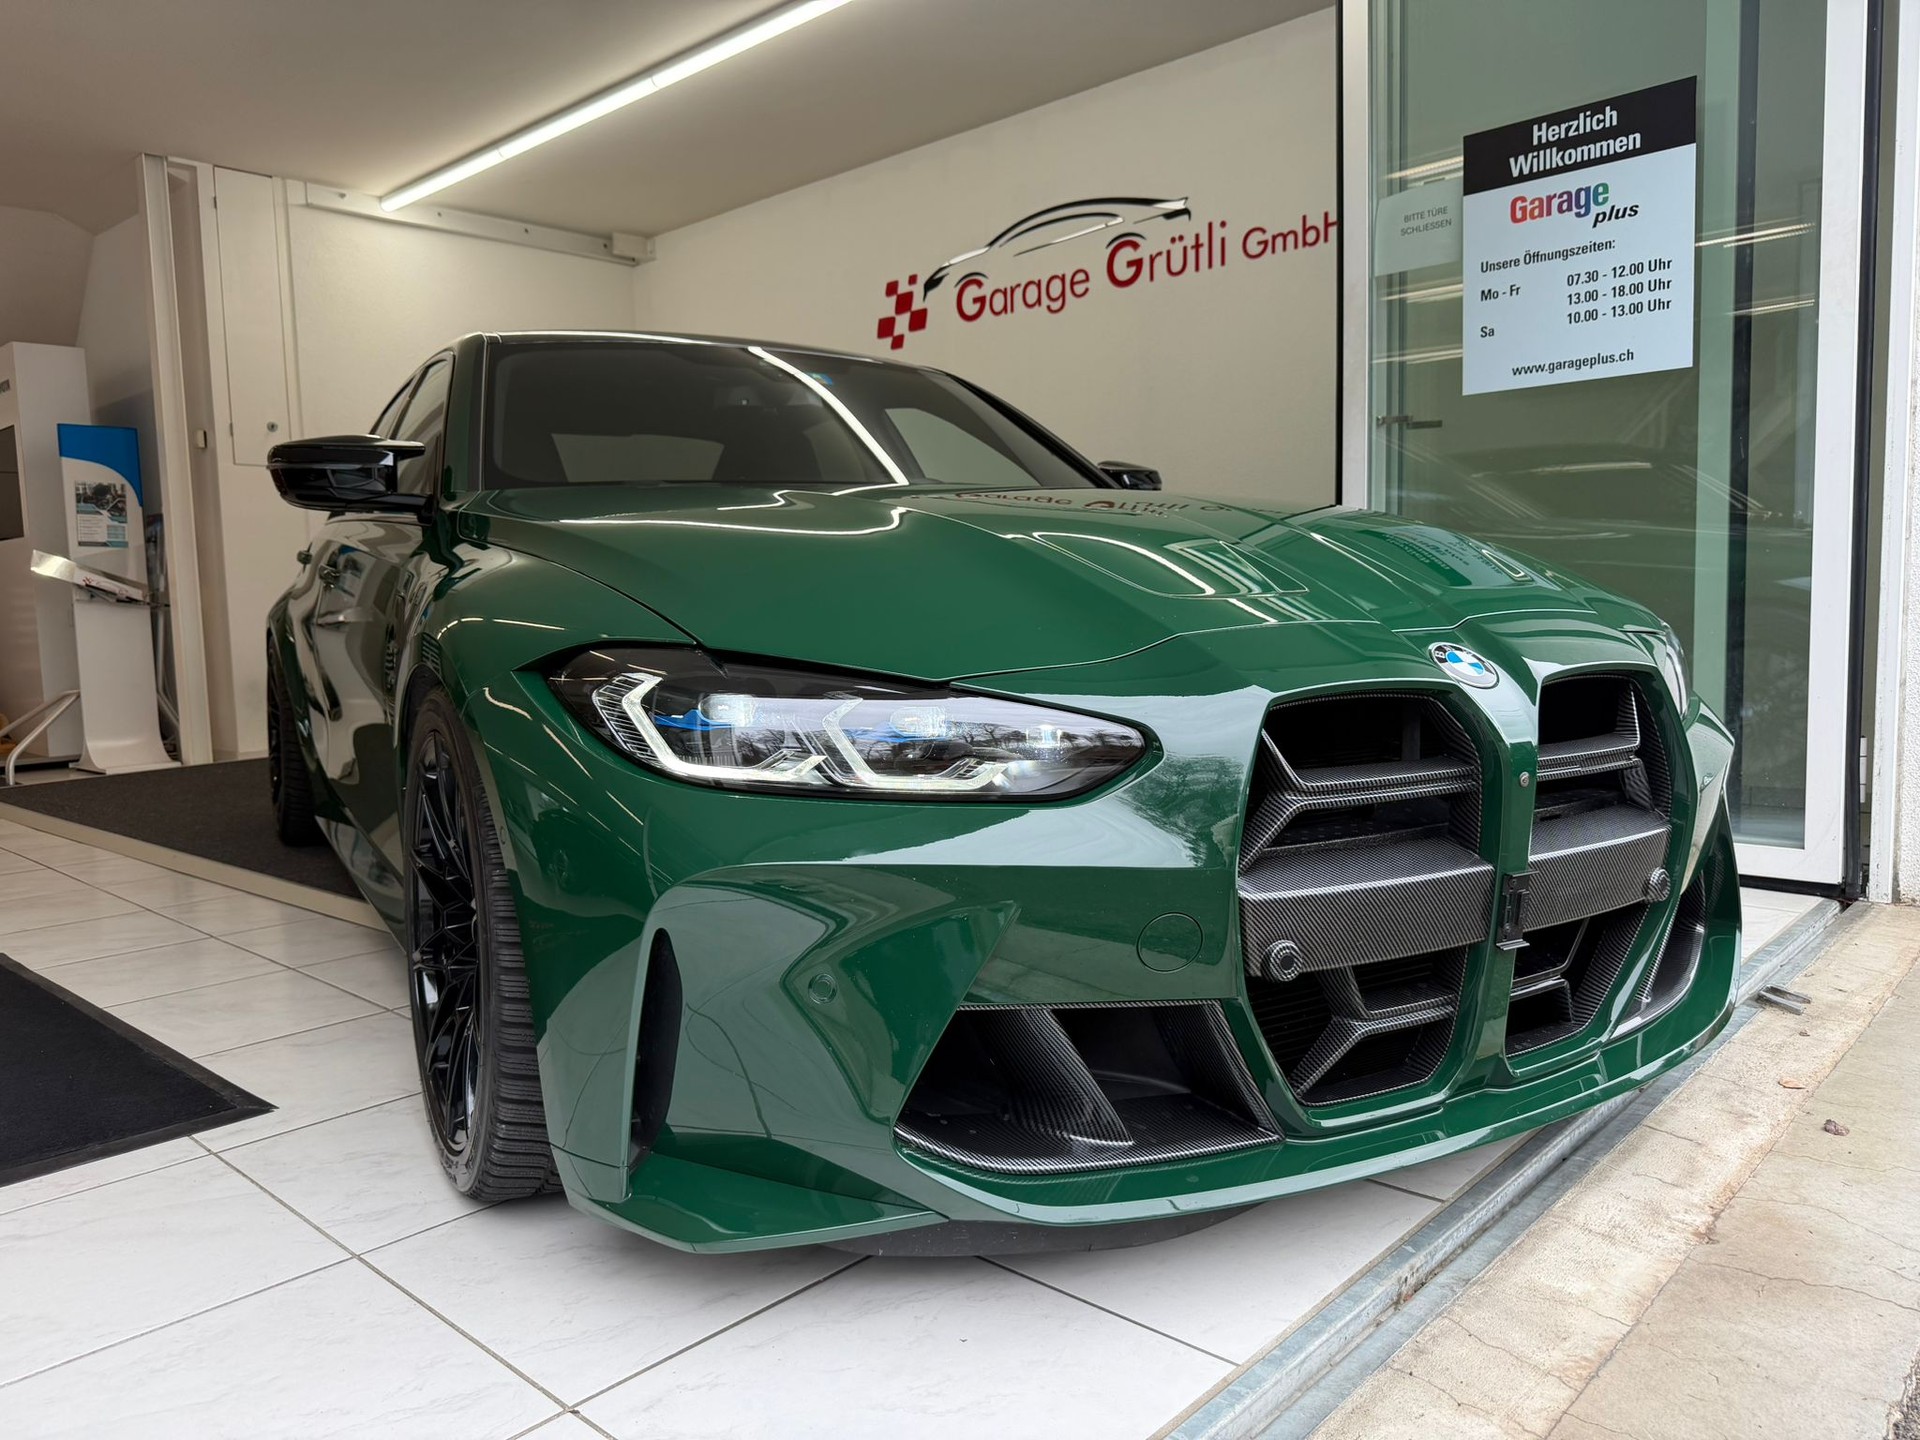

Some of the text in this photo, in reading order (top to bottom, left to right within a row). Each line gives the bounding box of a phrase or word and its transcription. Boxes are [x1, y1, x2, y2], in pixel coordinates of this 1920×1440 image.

[1532, 105, 1618, 146] Herzlich
[1508, 132, 1642, 178] Willkommen
[1403, 205, 1449, 223] BITTE TÜRE
[1509, 182, 1610, 224] Garage
[1592, 204, 1640, 229] plus
[1400, 218, 1452, 236] SCHLIESSEN
[1480, 239, 1616, 273] Unsere Öffnungszeiten:
[955, 268, 1090, 322] Garage
[1106, 219, 1227, 288] Grütli
[1566, 270, 1599, 287] 07.30
[1611, 262, 1644, 279] 12.00
[1648, 258, 1673, 272] Uhr
[1480, 287, 1499, 301] Mo
[1509, 284, 1521, 297] Fr
[1566, 289, 1599, 306] 13.00
[1611, 282, 1644, 298] 18.00
[1648, 278, 1673, 292] Uhr
[1566, 309, 1599, 325] 10.00
[1611, 302, 1644, 318] 13.00
[1647, 298, 1672, 312] Uhr
[1480, 326, 1495, 338] Sa
[1511, 349, 1635, 376] www.garageplus.ch
